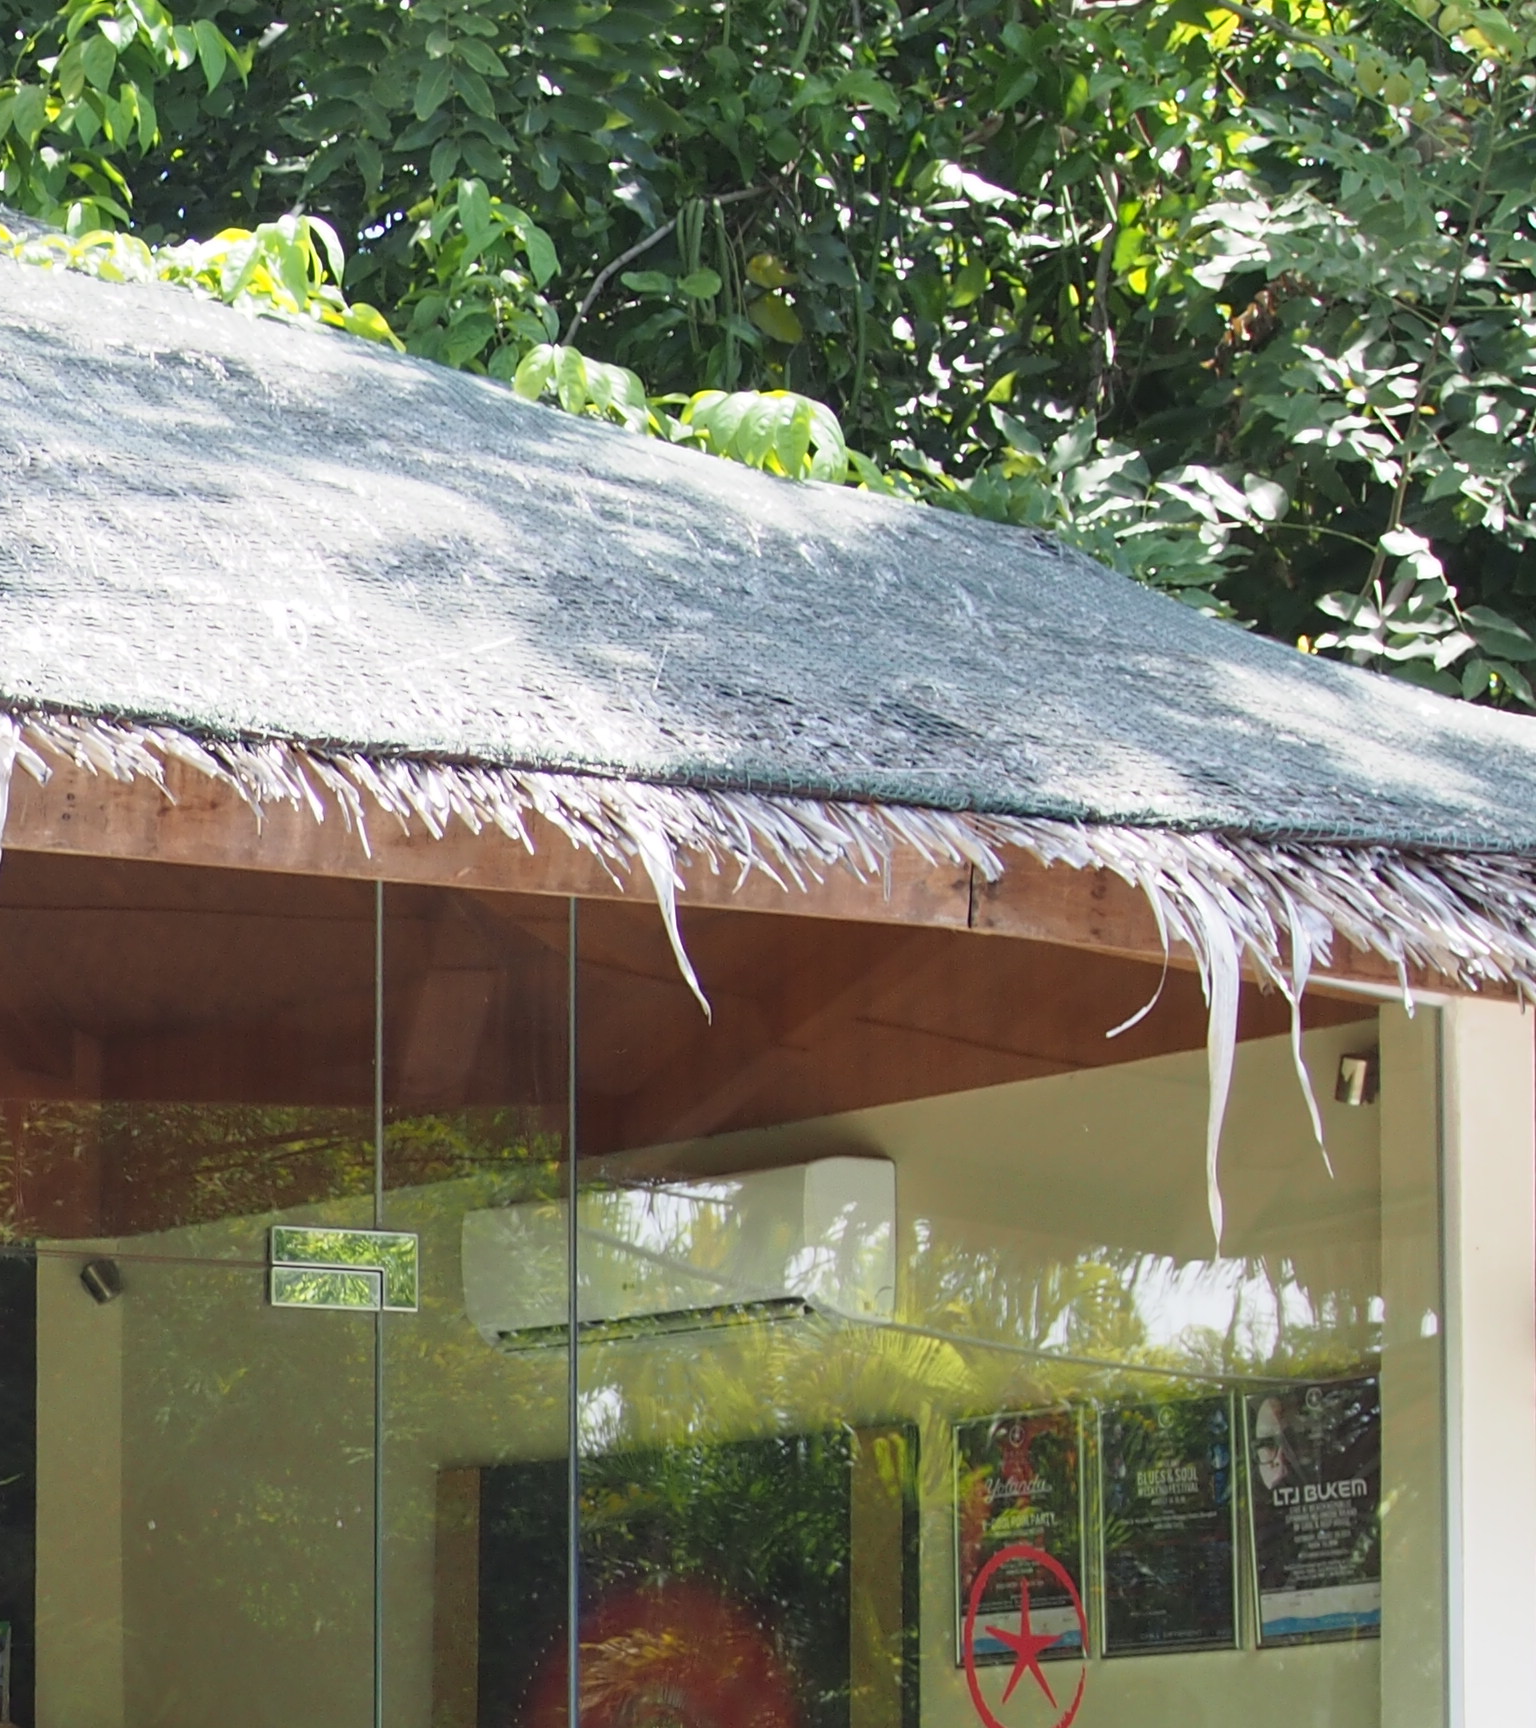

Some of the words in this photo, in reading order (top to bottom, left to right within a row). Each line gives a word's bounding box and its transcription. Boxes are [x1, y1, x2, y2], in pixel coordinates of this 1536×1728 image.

[985, 1474, 1053, 1505] Yolanda
[1136, 1469, 1166, 1486] BLUES
[1175, 1465, 1199, 1482] SOUL
[1273, 1486, 1300, 1507] LTJ
[1303, 1477, 1368, 1503] BUKEM
